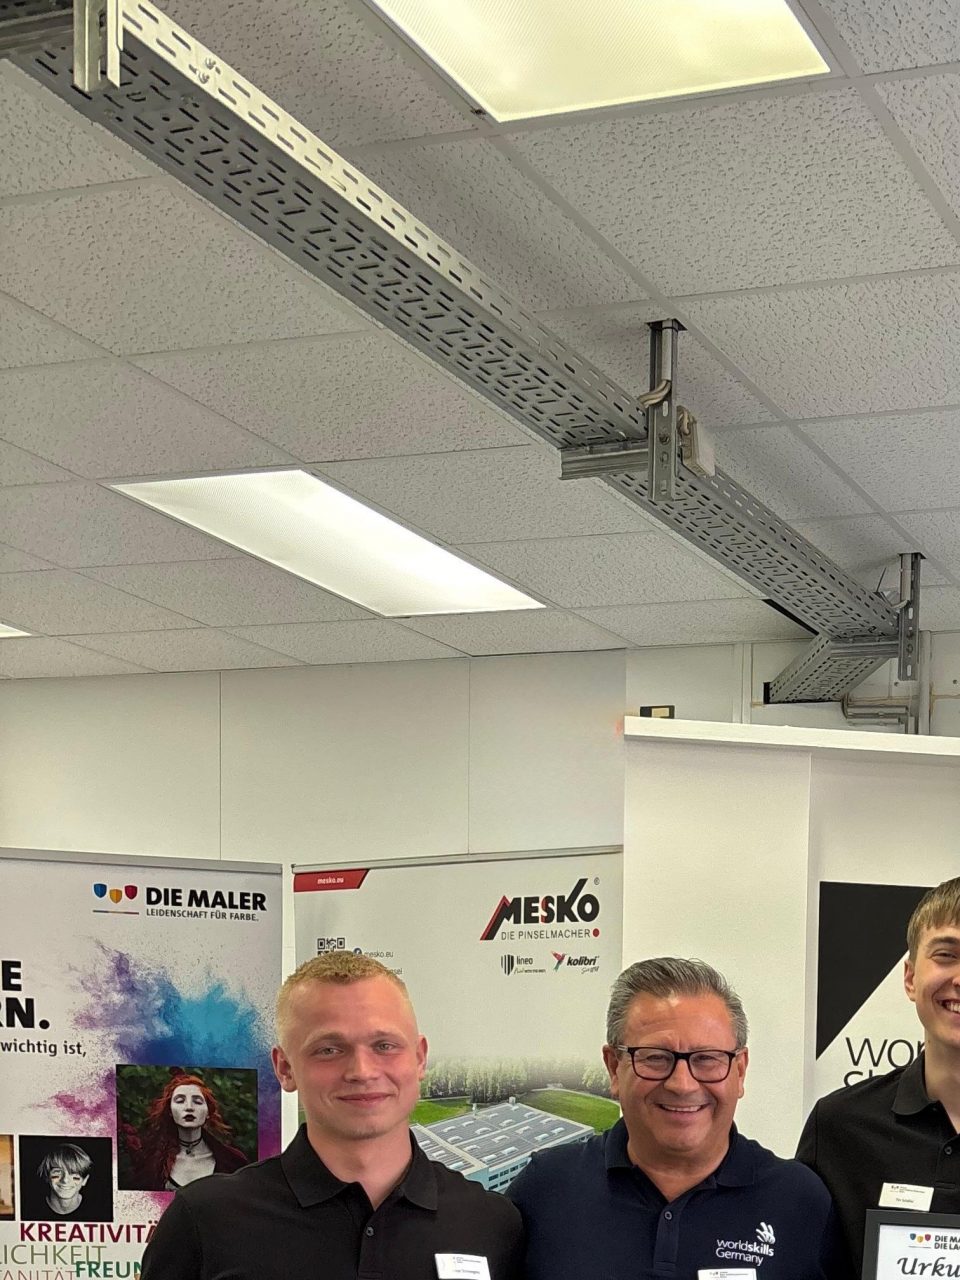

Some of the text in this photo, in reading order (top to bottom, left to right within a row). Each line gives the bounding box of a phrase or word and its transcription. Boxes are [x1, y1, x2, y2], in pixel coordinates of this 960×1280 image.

[317, 877, 344, 885] mesko.eu
[146, 887, 267, 911] DIE MALER
[146, 908, 259, 922] LEIDENSCHAFT FÜR FARBE.
[480, 878, 600, 941] MESKO
[501, 928, 591, 941] DIE PINSELMACHER
[0, 997, 50, 1029] N.
[0, 1038, 87, 1057] wichtig ist,
[934, 1234, 947, 1242] DIE
[0, 1244, 107, 1266] ICHKEIT
[715, 1247, 764, 1266] Germany
[716, 1239, 775, 1257] worldskills
